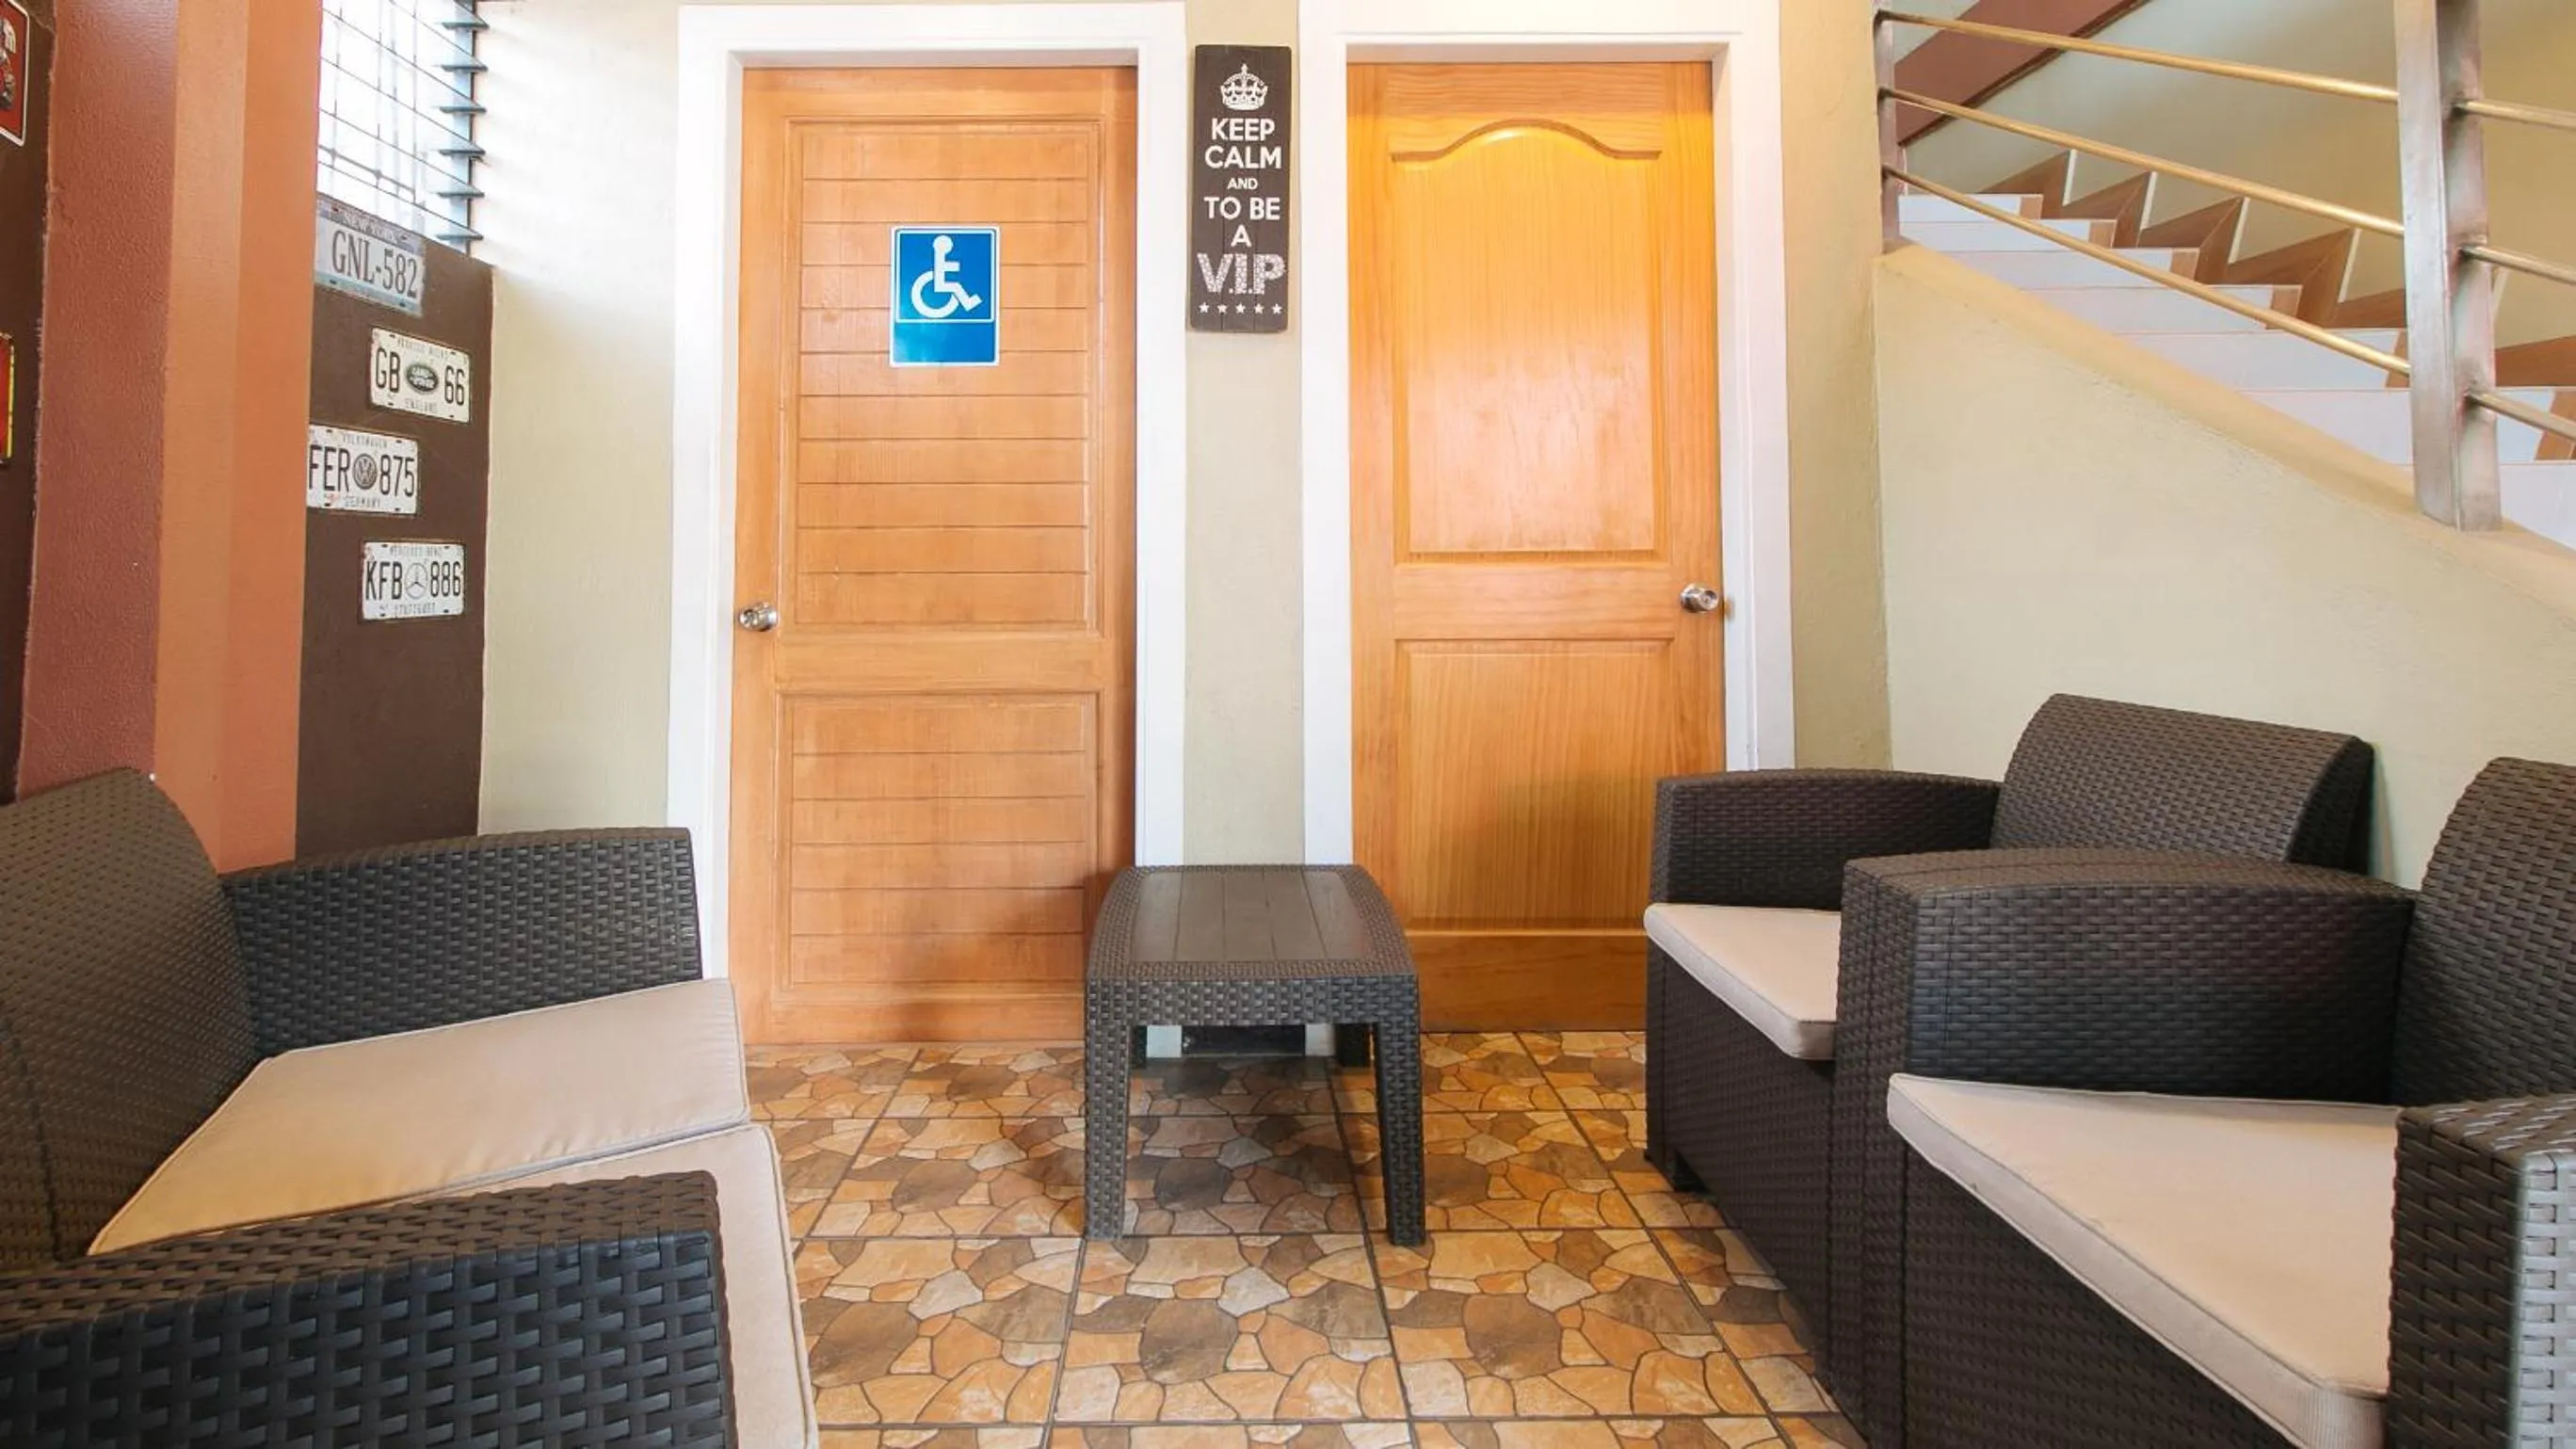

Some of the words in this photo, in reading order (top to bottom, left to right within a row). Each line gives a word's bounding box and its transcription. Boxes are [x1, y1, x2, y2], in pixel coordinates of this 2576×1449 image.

[1211, 118, 1275, 141] KEEP
[1204, 145, 1282, 169] CALM
[1227, 177, 1258, 189] AND
[1203, 196, 1242, 220] TO
[1249, 196, 1280, 220] BE
[1231, 224, 1251, 248] A
[331, 229, 418, 298] GNL-582
[376, 347, 401, 394] GB
[444, 364, 464, 407] 66
[309, 443, 350, 492] FER
[379, 454, 414, 498] 875
[365, 560, 403, 601] KFB
[430, 560, 461, 598] 886
